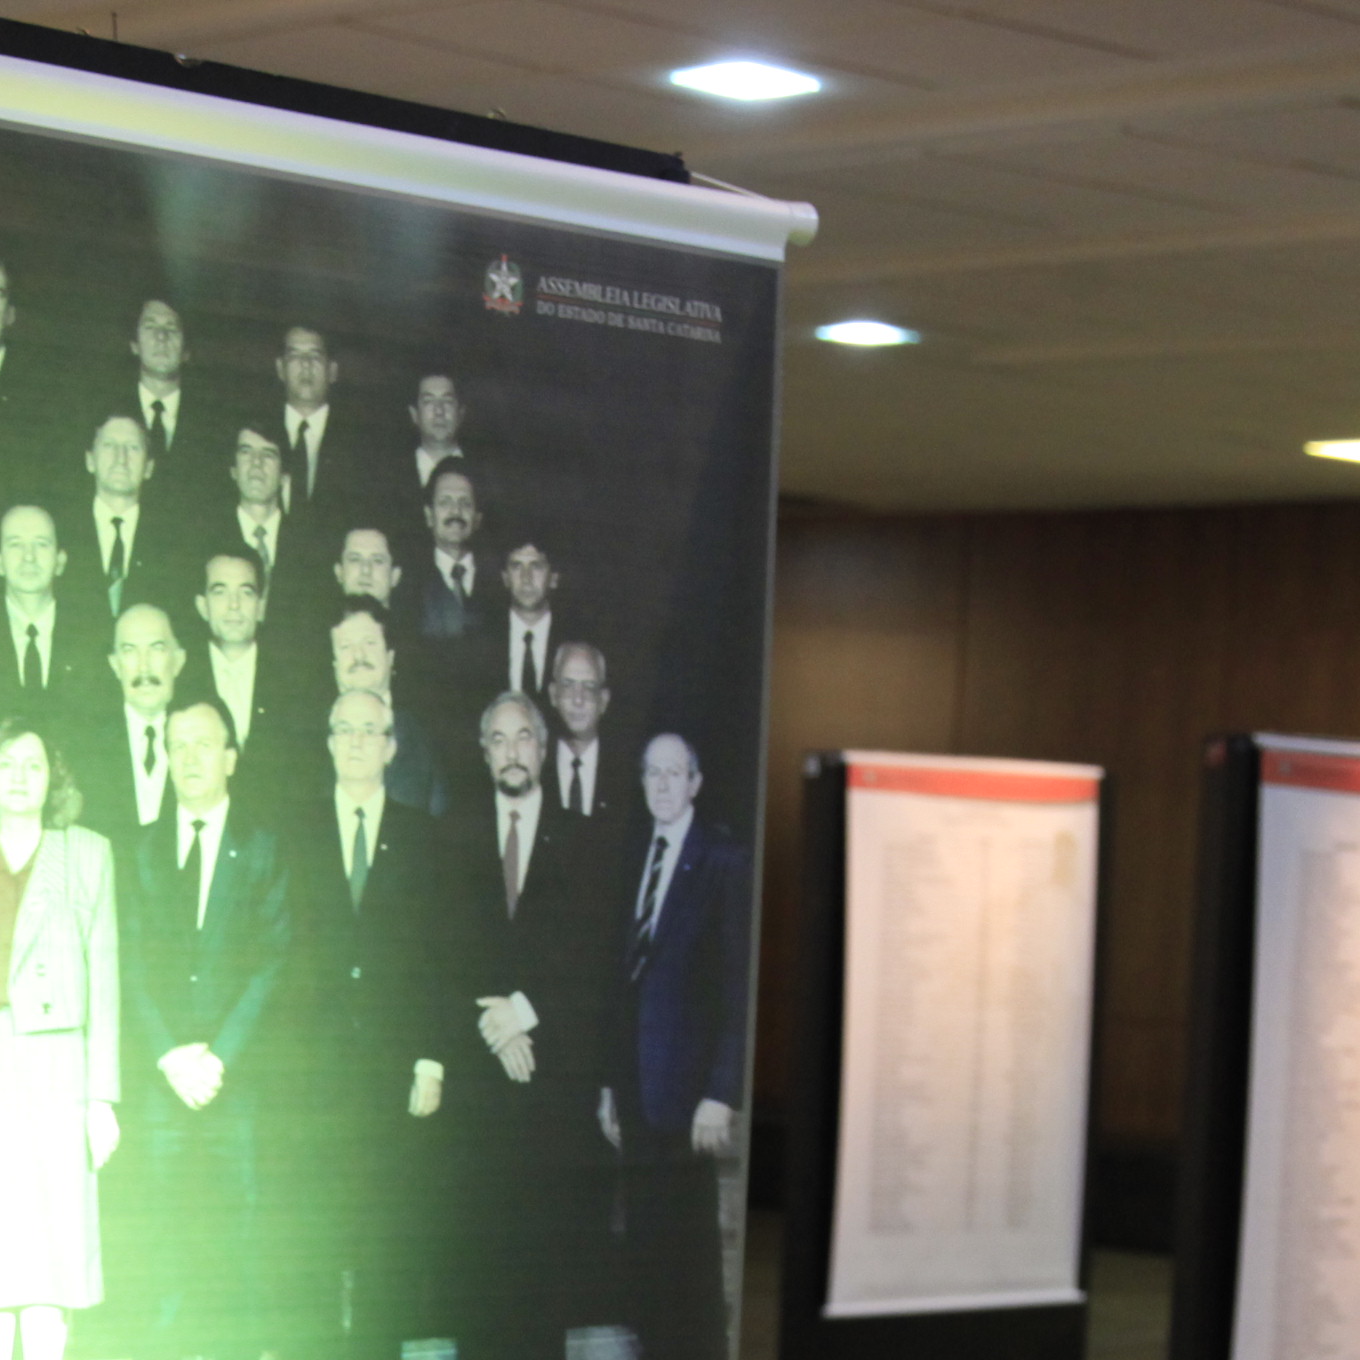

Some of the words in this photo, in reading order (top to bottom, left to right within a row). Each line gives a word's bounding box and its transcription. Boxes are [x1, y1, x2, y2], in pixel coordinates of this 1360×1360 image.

[537, 276, 630, 306] ASSEMBLEIA
[633, 290, 722, 322] LEGISLATIVA
[536, 300, 555, 316] DO
[558, 303, 606, 324] ESTADO
[608, 311, 625, 328] DE
[628, 315, 665, 334] SANTA
[667, 321, 723, 343] CATARINA
